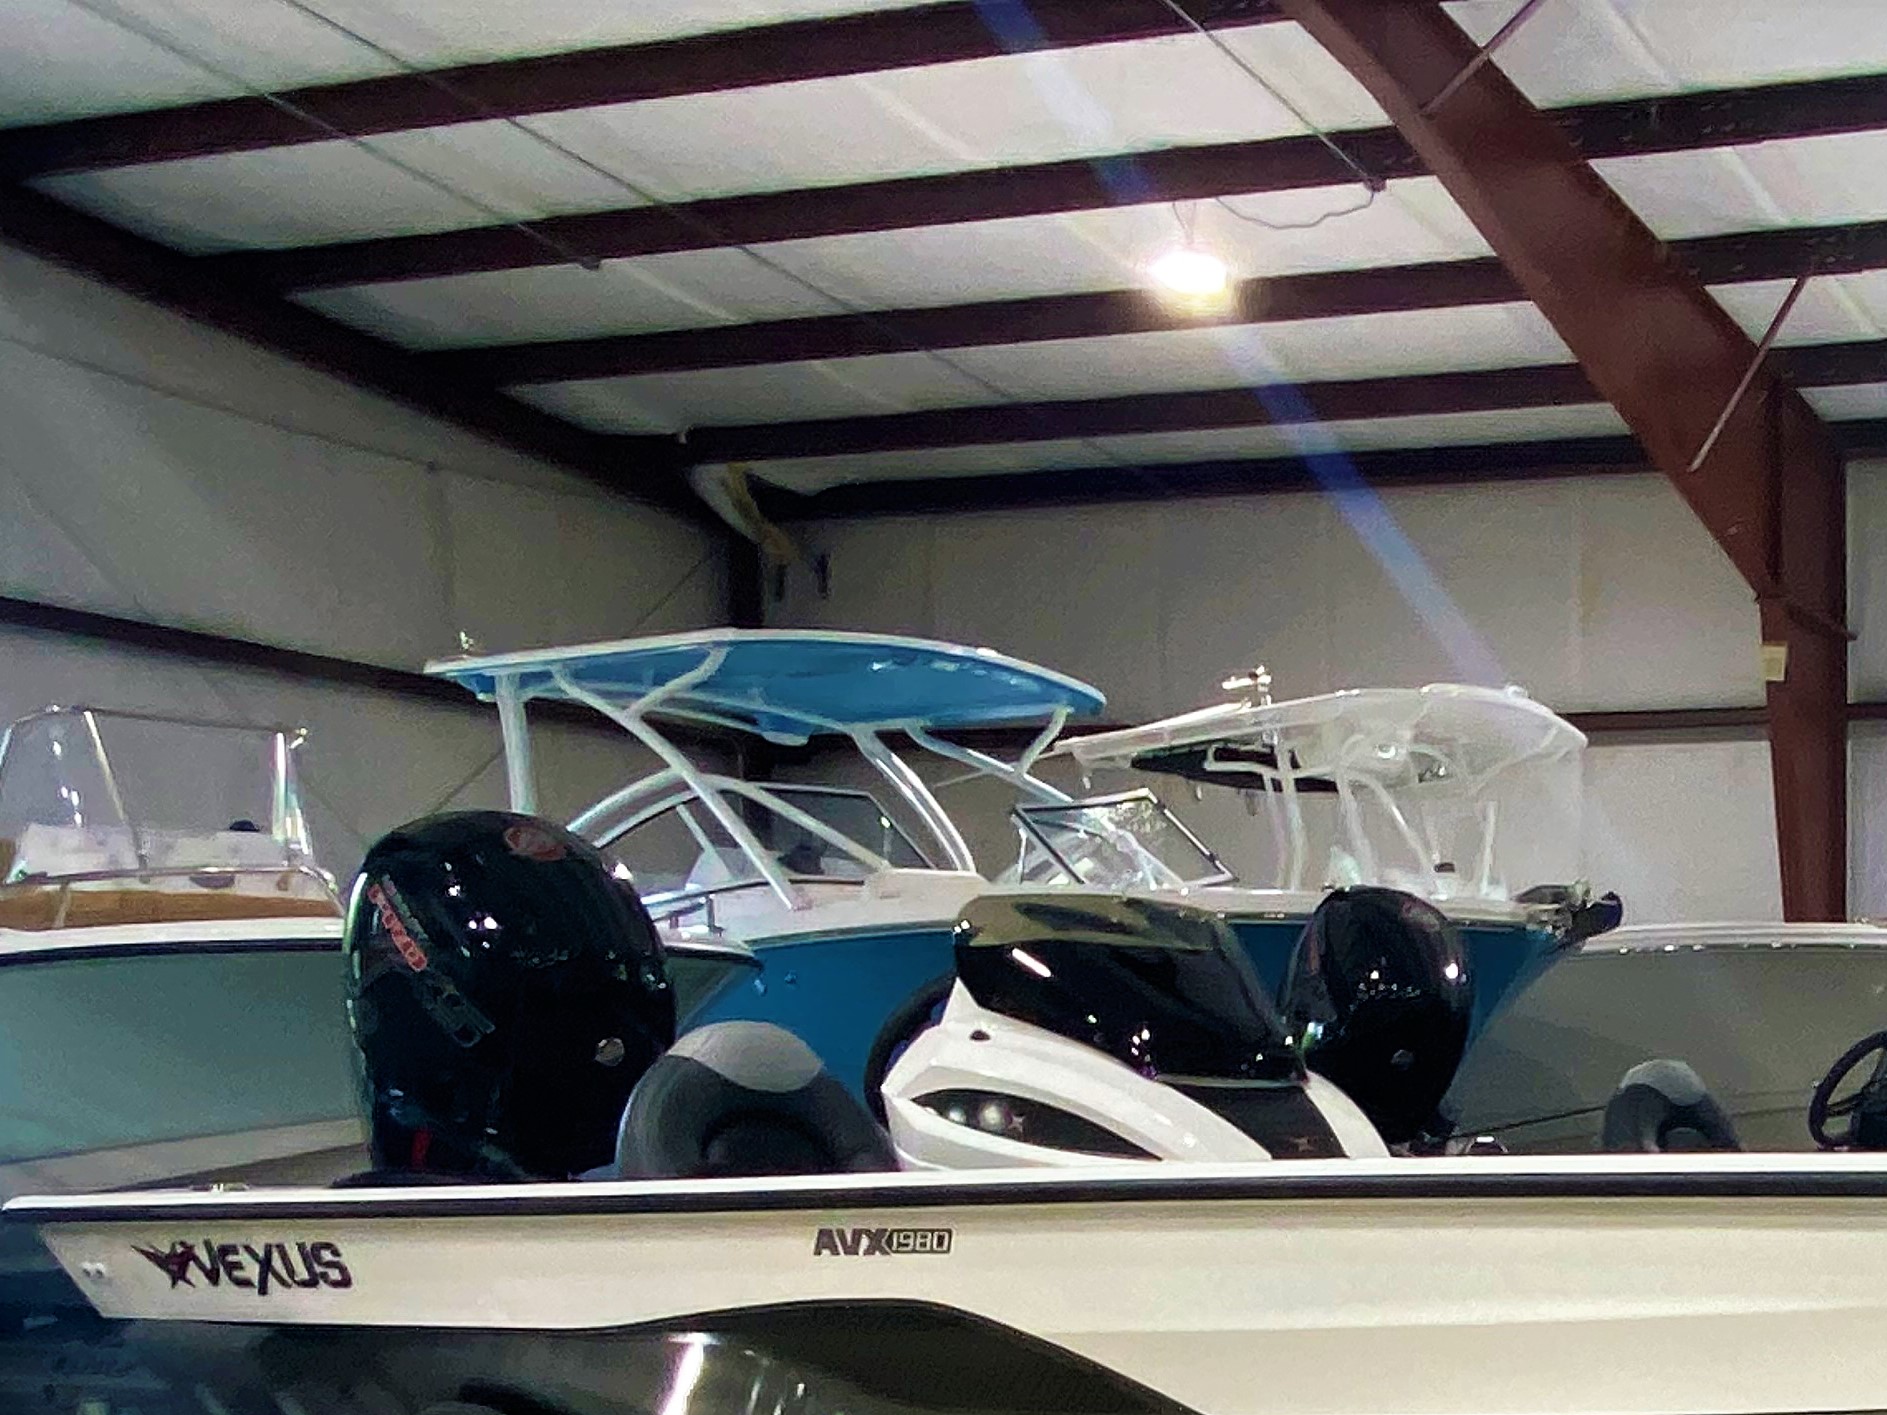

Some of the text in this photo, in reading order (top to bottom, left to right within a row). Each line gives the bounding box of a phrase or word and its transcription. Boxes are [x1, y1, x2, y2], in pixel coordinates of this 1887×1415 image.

[814, 1228, 949, 1256] AVX 1980
[188, 1239, 352, 1296] VEXUS
